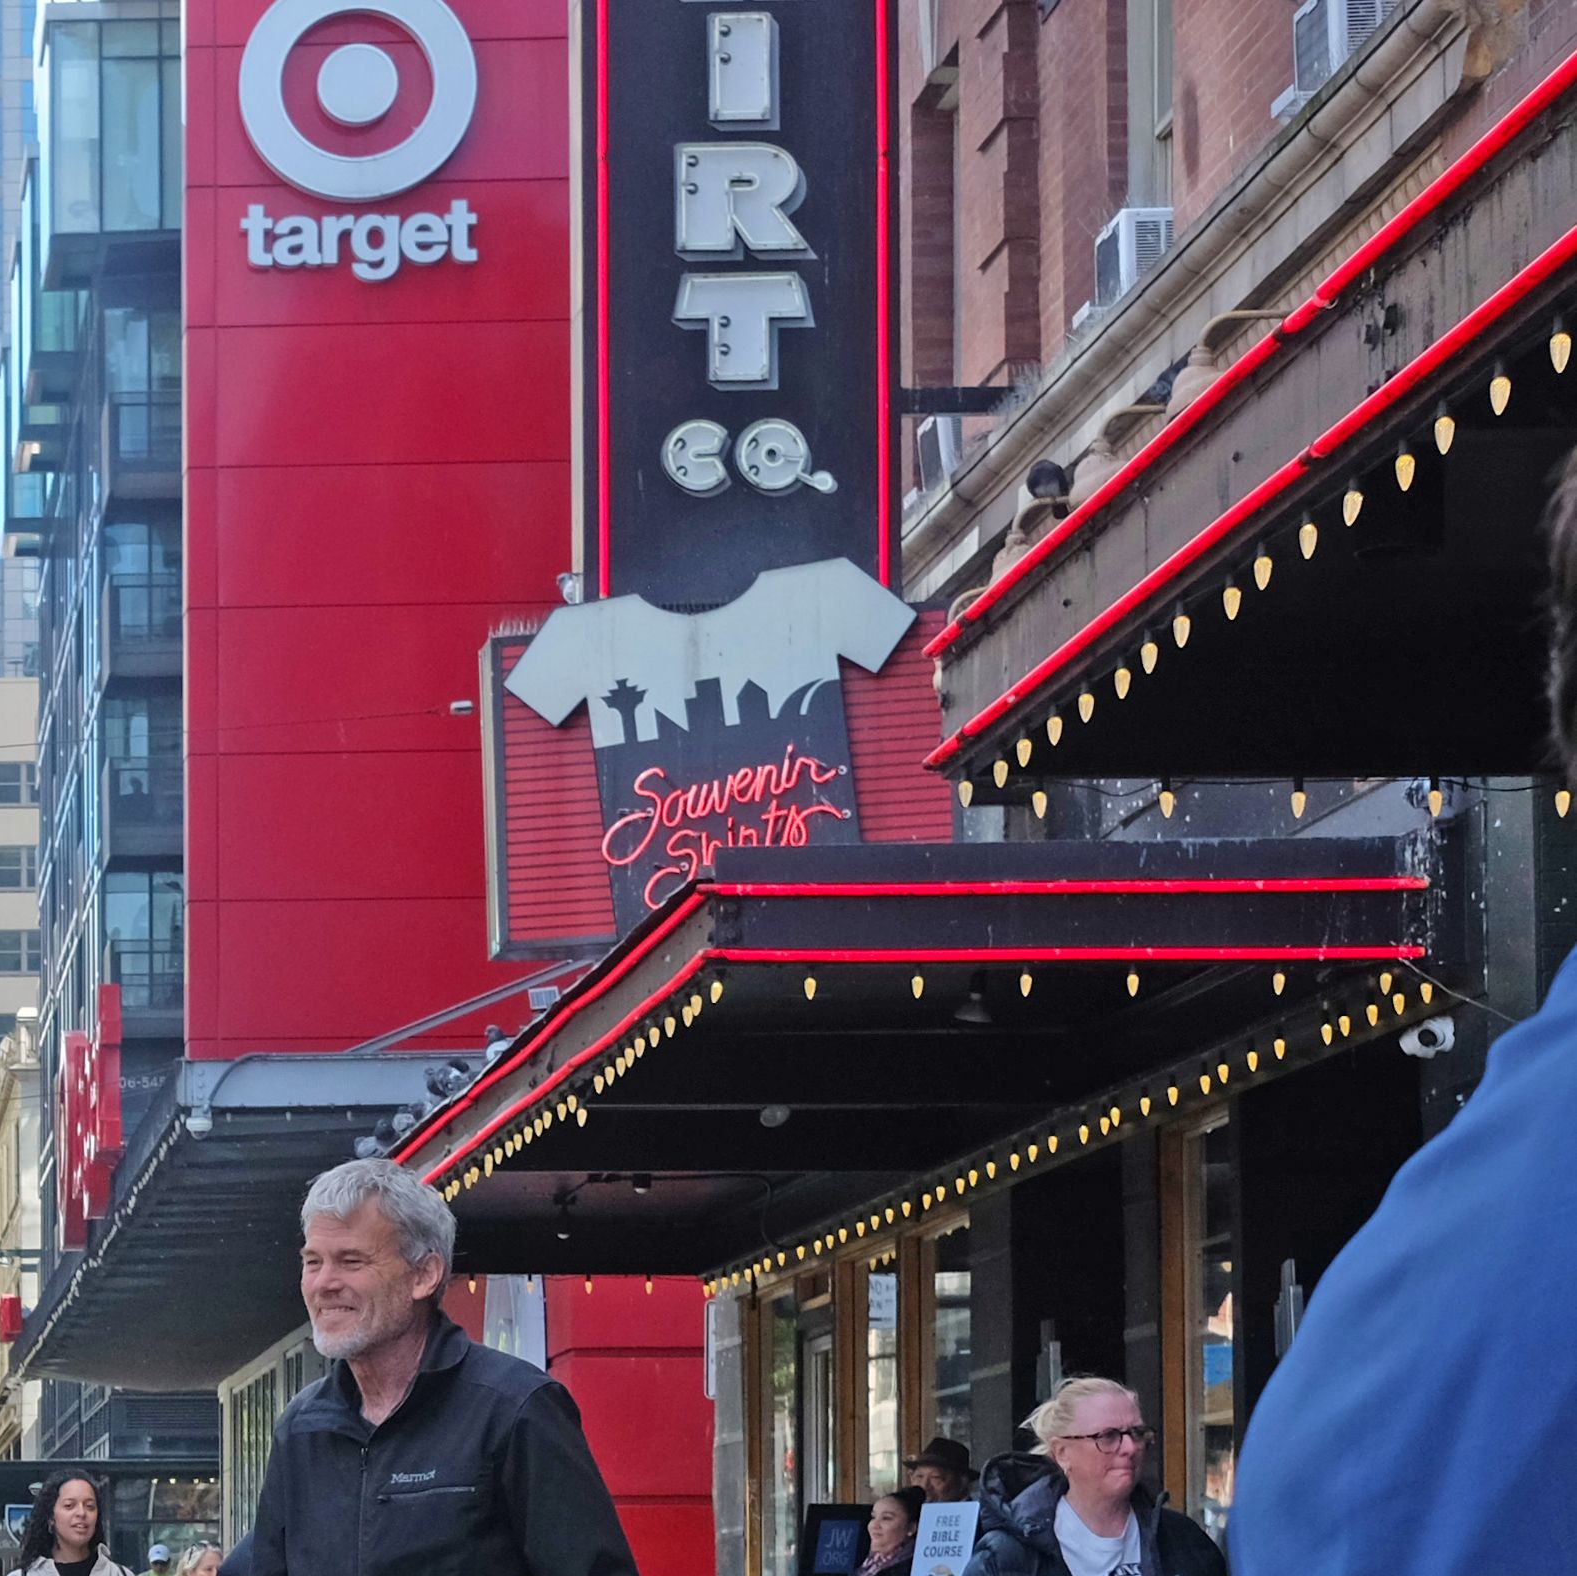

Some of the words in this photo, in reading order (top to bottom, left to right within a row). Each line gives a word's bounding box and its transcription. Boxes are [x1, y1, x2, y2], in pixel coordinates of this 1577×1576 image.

[672, 0, 819, 391] IRT
[240, 199, 479, 282] target
[602, 740, 839, 866] Souvenir
[390, 1468, 437, 1484] Marmot
[934, 1514, 962, 1528] FREE
[824, 1527, 854, 1548] JW
[930, 1530, 961, 1543] BIBLE
[922, 1545, 964, 1558] COURSE
